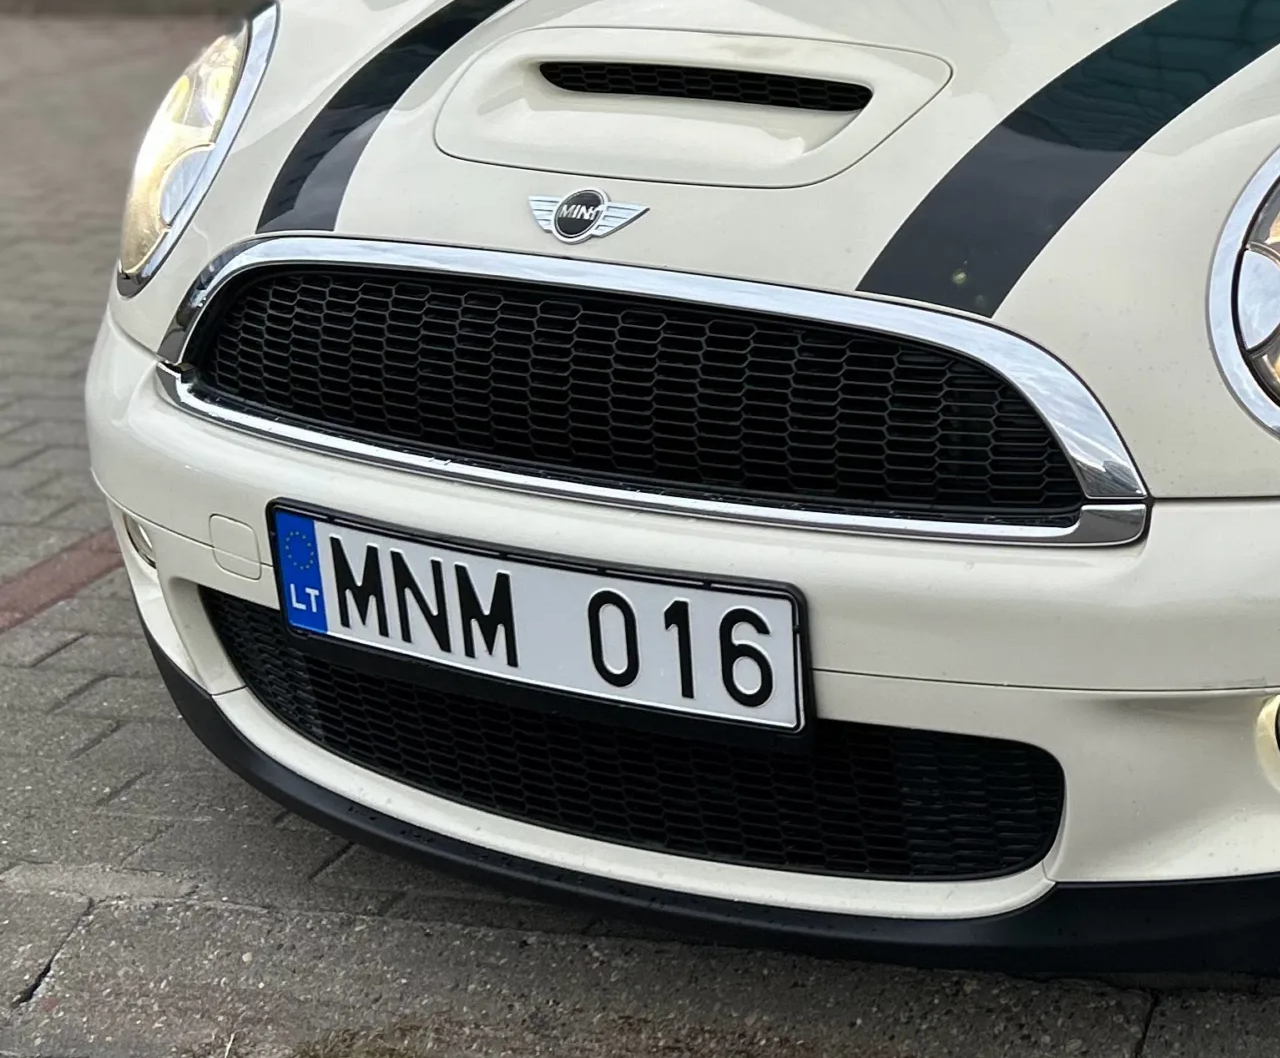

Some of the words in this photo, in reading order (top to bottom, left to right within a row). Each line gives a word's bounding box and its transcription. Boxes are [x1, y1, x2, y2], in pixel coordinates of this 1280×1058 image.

[559, 204, 598, 221] MINI
[290, 583, 320, 613] LT
[329, 535, 519, 669] MNM
[587, 589, 774, 708] 016
